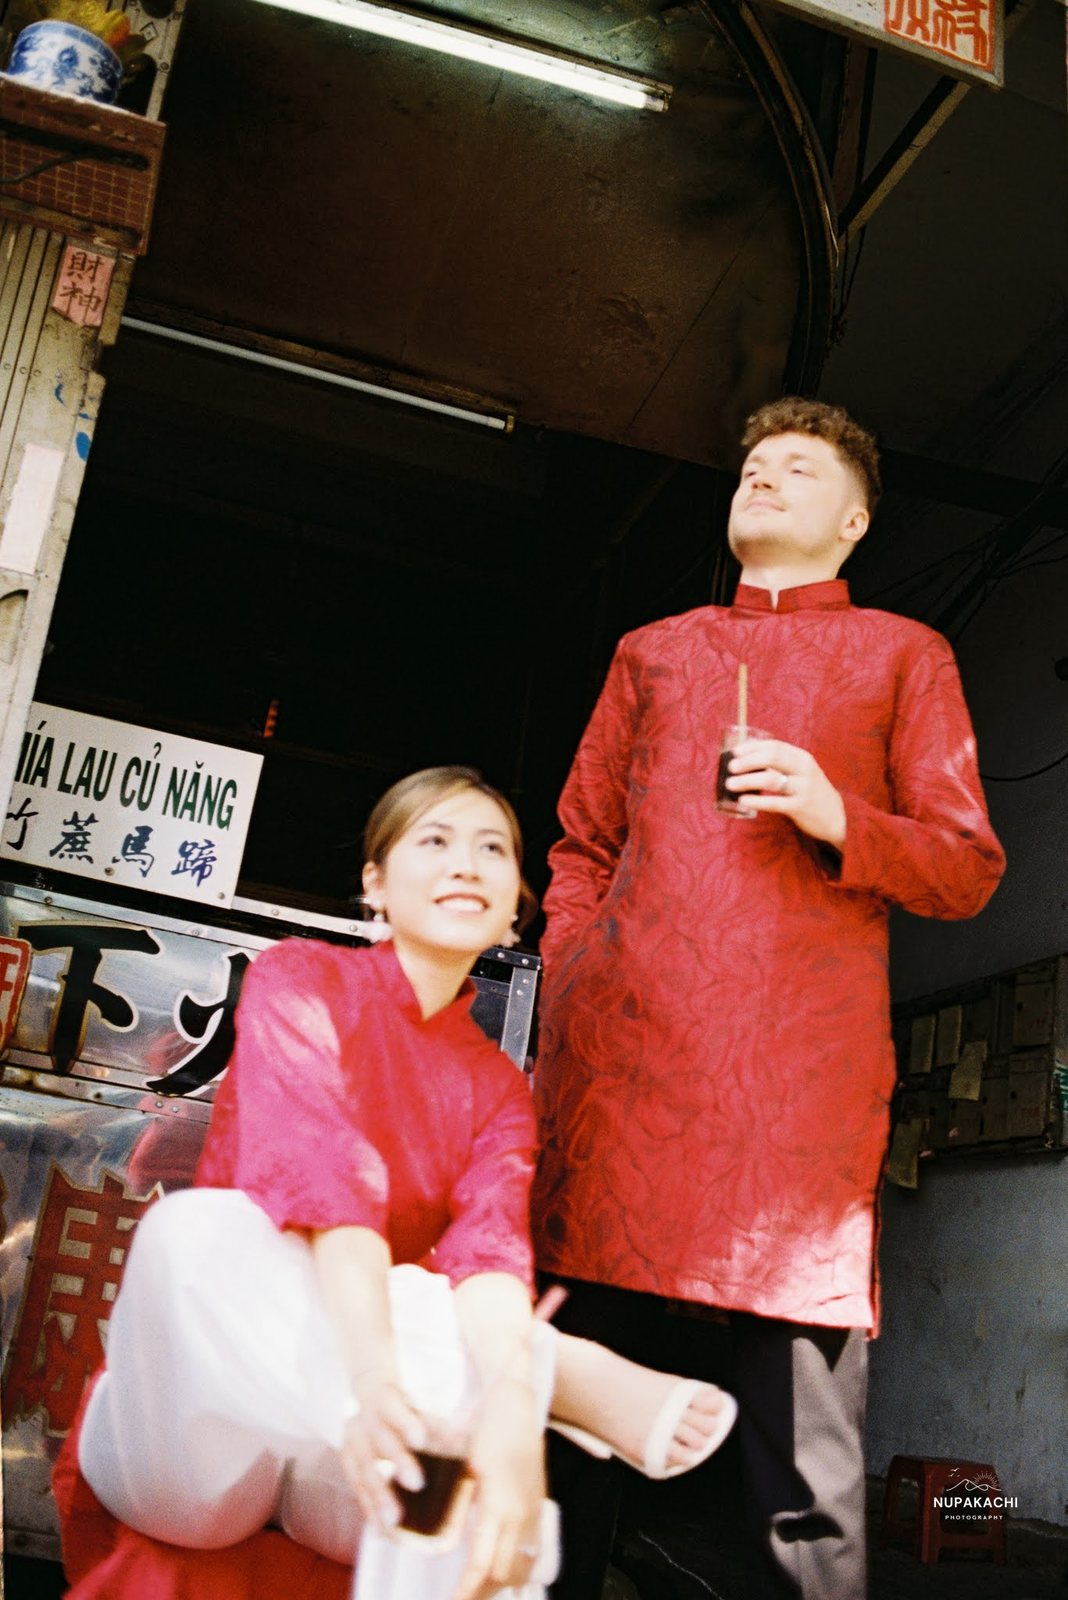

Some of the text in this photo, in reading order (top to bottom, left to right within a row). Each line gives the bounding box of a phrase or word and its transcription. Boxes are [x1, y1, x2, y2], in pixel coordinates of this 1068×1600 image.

[59, 252, 105, 323] 財神
[57, 742, 118, 801] LAU
[120, 741, 162, 811] CỦ
[162, 760, 238, 831] NĂNG
